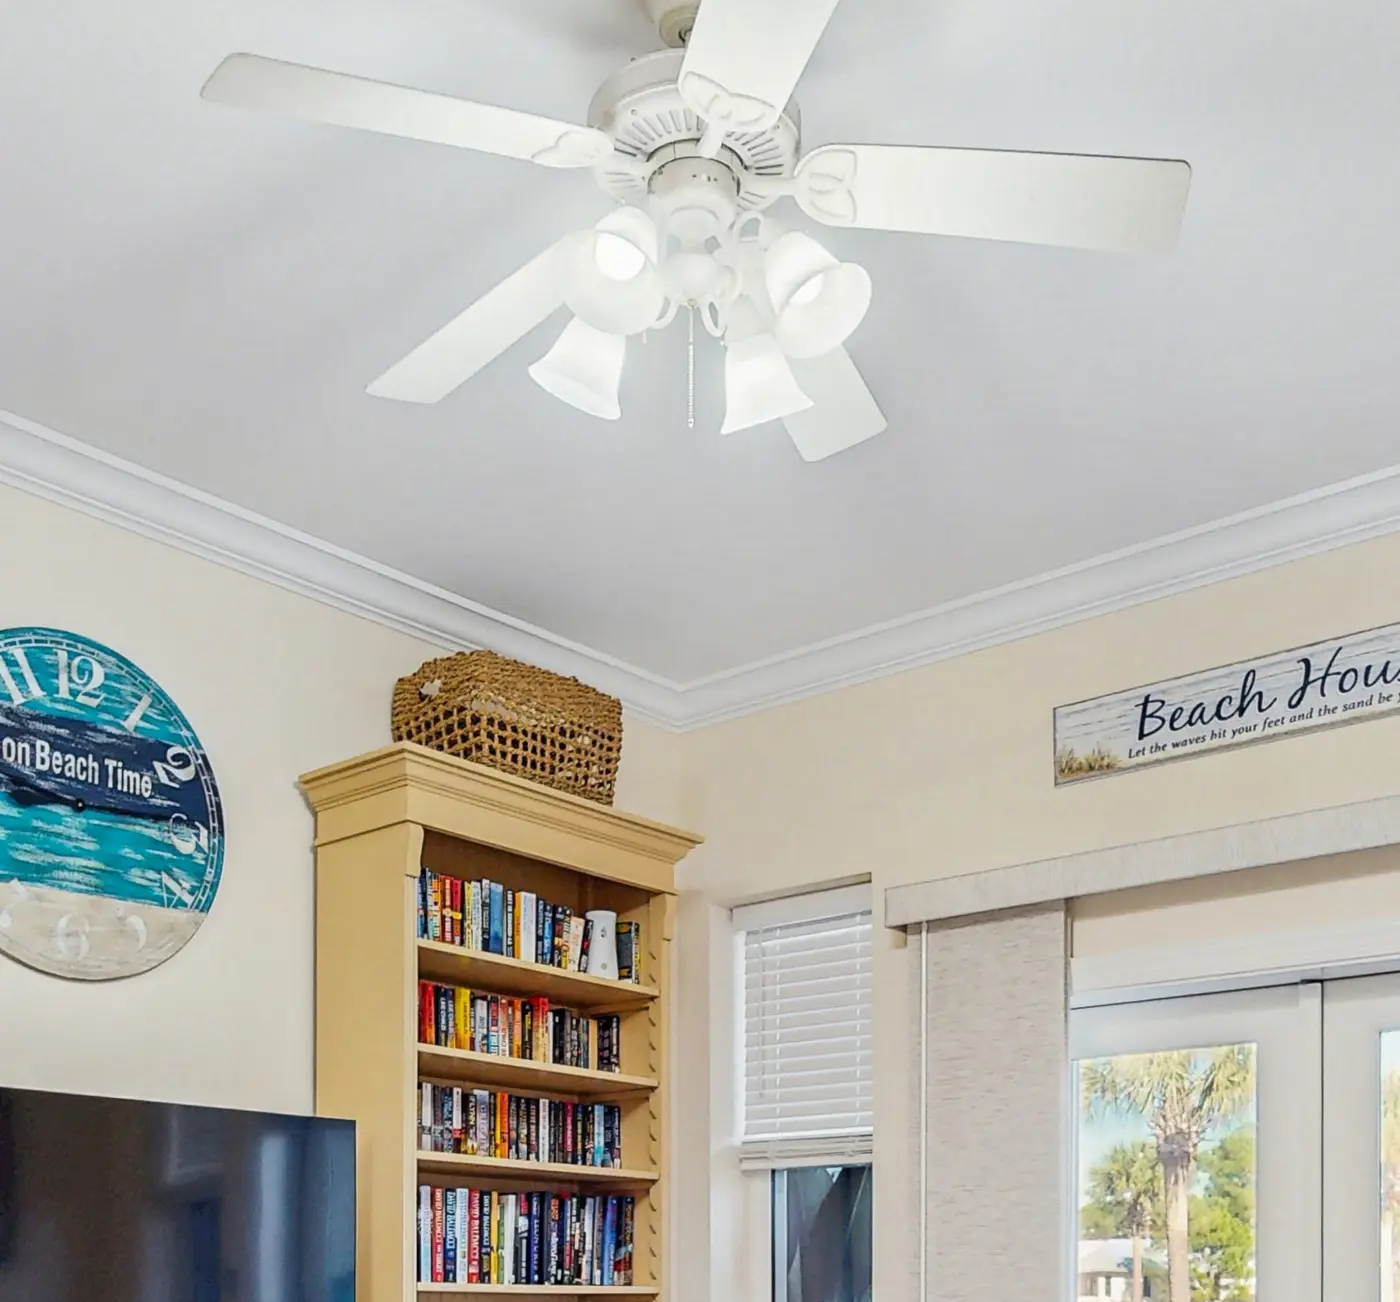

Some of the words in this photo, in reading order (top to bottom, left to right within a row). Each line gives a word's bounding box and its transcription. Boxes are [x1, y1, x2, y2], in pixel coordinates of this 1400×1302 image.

[52, 649, 105, 707] 12
[1134, 668, 1277, 741] Beach
[1128, 747, 1146, 759] Let
[1149, 742, 1168, 755] the
[1171, 734, 1206, 749] waves
[1210, 729, 1227, 741] hit
[1231, 723, 1258, 739] your
[1262, 716, 1286, 732] feet
[1289, 707, 1314, 723] and
[1318, 704, 1339, 717] the
[1342, 694, 1374, 713] sand
[1378, 692, 1394, 704] be
[2, 736, 31, 762] on
[35, 739, 99, 786] Beach
[104, 758, 152, 799] Time
[152, 745, 197, 789] 2
[435, 1189, 443, 1210] DAVID
[446, 1191, 456, 1214] DAVID
[470, 1192, 479, 1218] DAVID
[435, 1210, 443, 1243] BALDACCI
[446, 1214, 456, 1249] BALDACCI
[470, 1219, 479, 1259] BALDACCI
